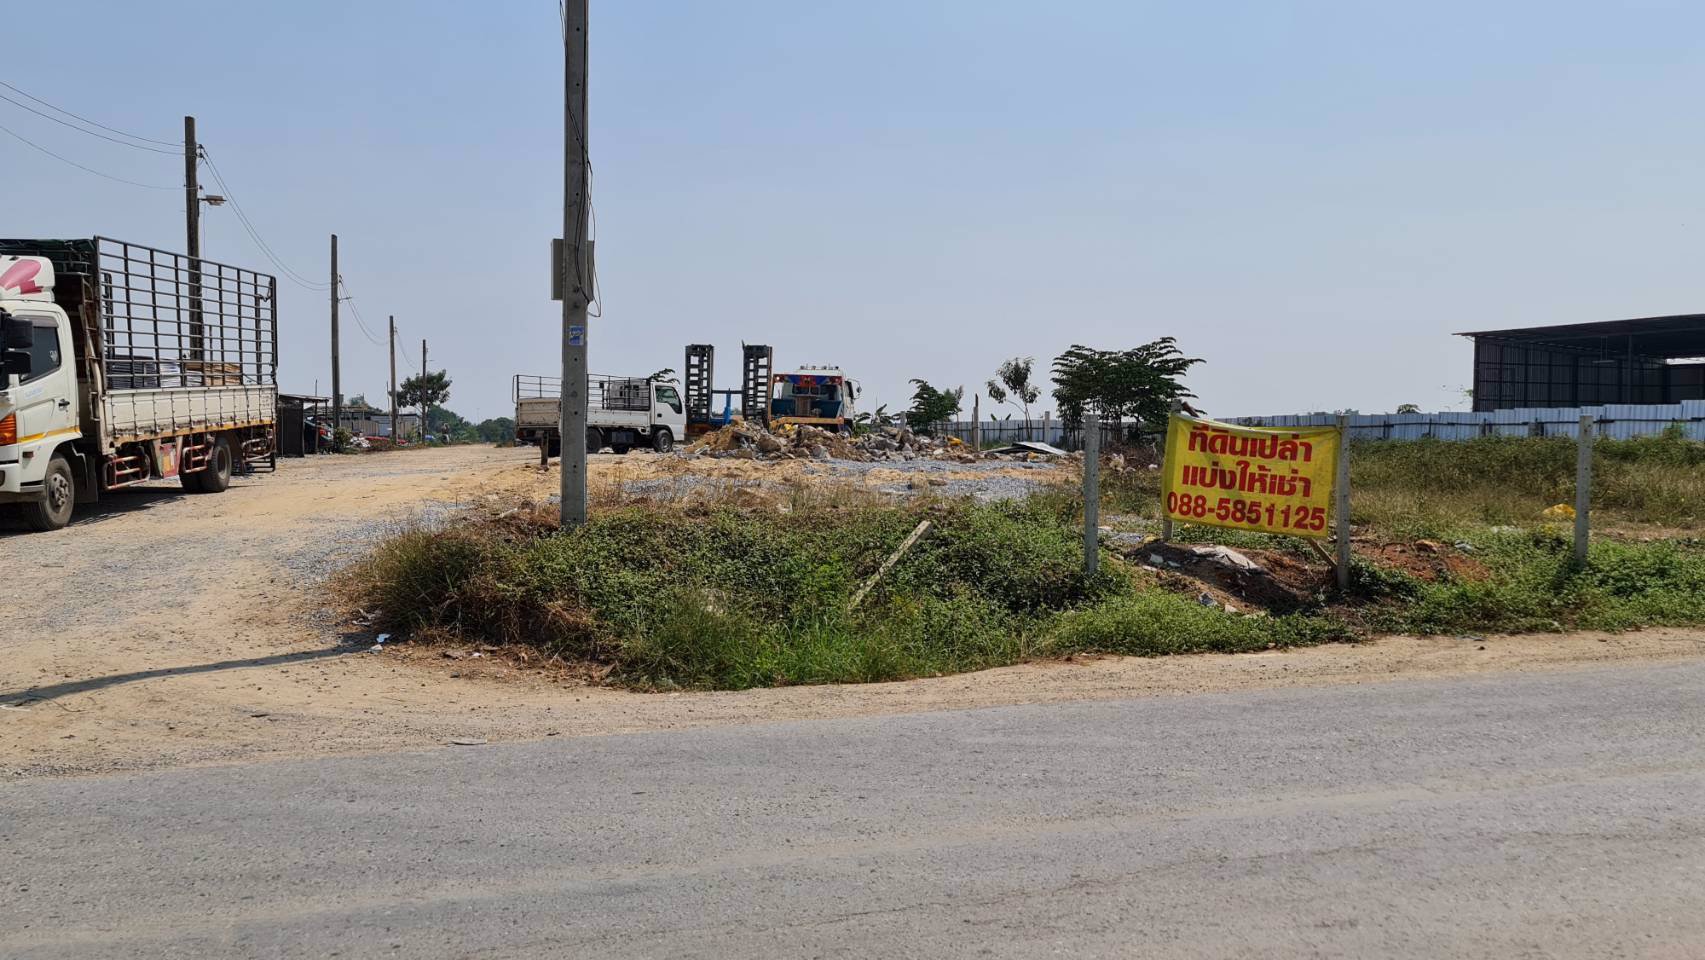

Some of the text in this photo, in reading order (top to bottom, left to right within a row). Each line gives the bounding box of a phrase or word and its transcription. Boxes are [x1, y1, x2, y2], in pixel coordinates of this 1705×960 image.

[1188, 423, 1313, 462] ทีดินเปล่า
[1182, 460, 1312, 498] แบ่งให้เช่า
[1167, 491, 1326, 531] 088-5851125
